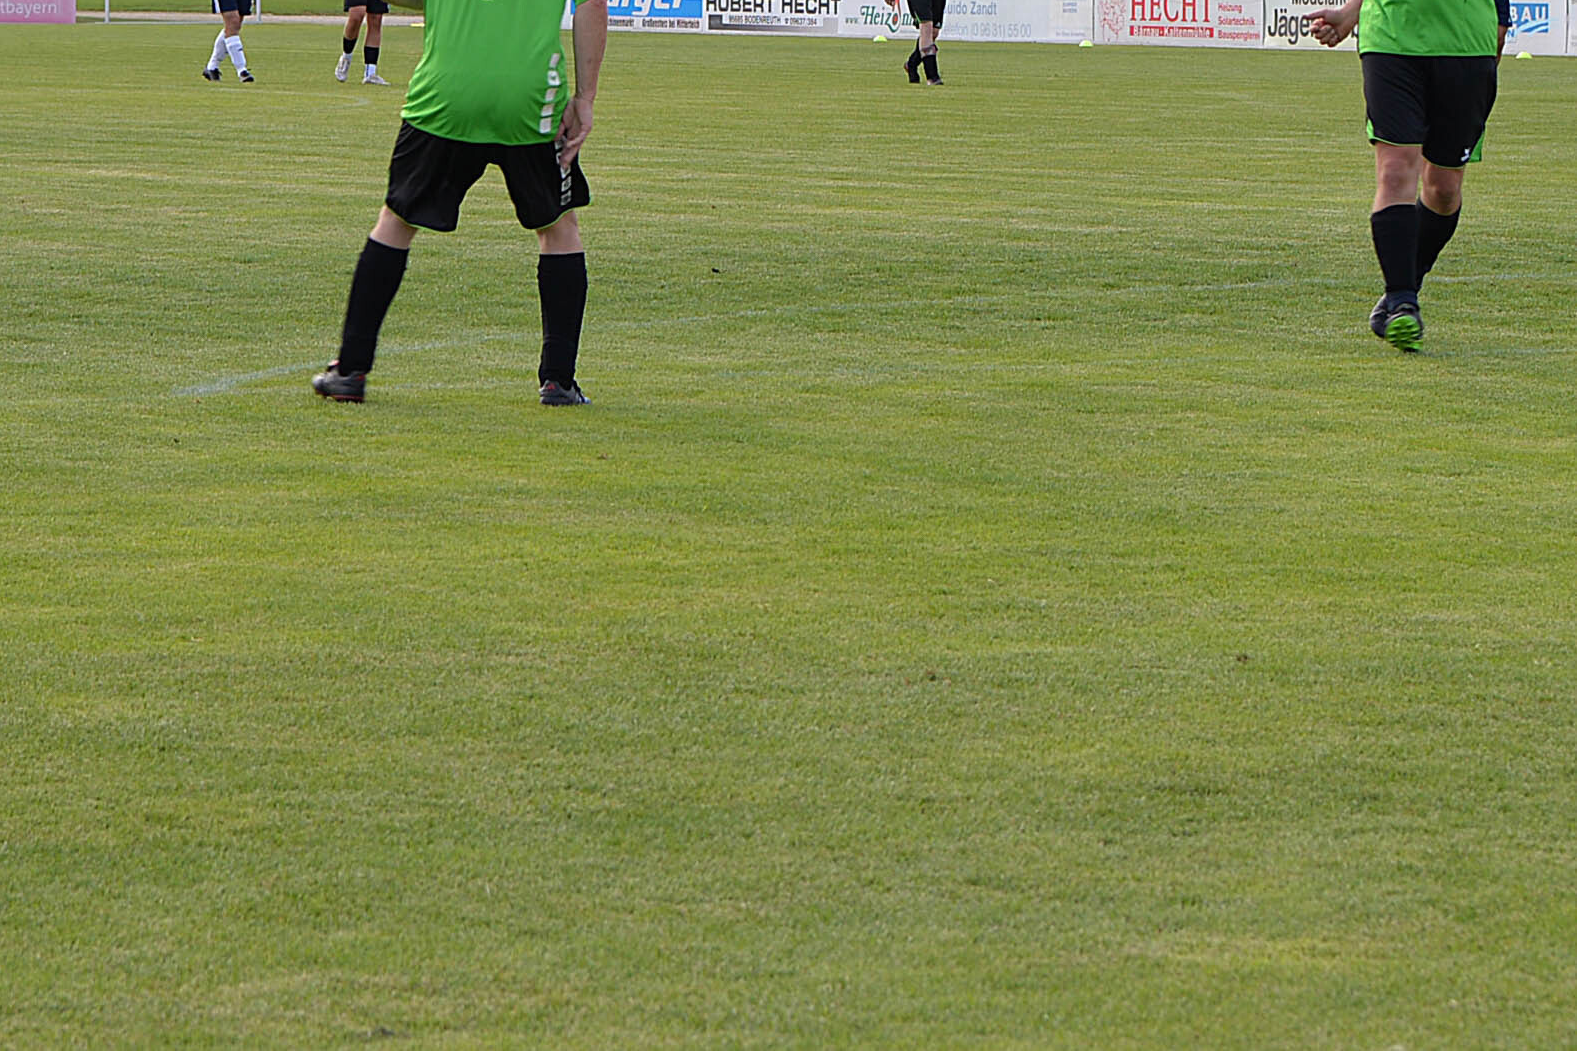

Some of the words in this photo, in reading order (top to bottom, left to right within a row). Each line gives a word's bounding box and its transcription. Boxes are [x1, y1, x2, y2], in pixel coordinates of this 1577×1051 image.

[943, 2, 968, 15] uido
[970, 1, 997, 16] Zandt
[1509, 6, 1546, 22] BAU
[1268, 8, 1315, 45] Jäge
